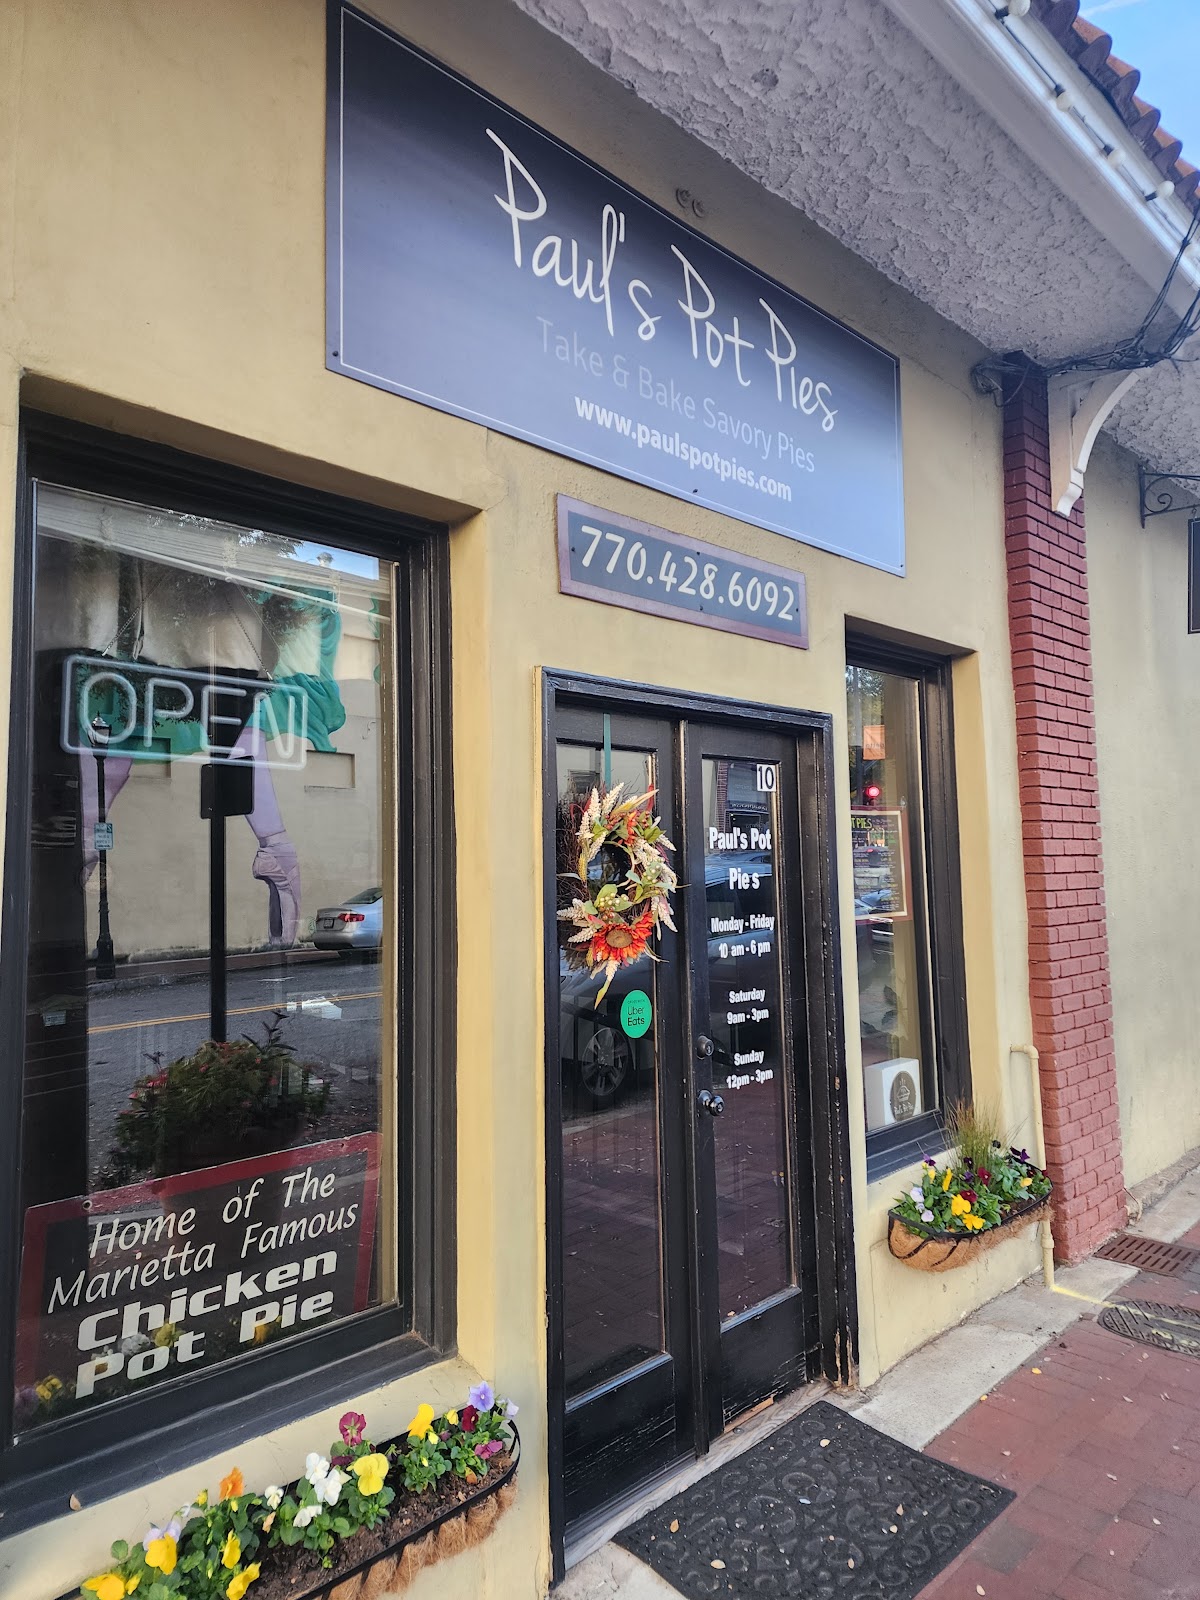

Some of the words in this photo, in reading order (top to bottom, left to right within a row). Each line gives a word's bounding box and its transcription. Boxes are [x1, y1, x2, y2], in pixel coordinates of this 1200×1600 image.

[486, 128, 662, 341] Paul's
[670, 244, 755, 388] Pot
[759, 298, 839, 432] Pies
[536, 316, 603, 377] Take
[613, 354, 631, 391] &
[639, 366, 696, 420] Bake
[704, 397, 773, 461] Savory
[778, 431, 816, 473] Pies
[574, 395, 793, 502] www.paulspotpies.com
[580, 525, 795, 621] 770.428.6092
[80, 671, 296, 761] OPEN
[758, 765, 775, 790] 10
[709, 826, 749, 850] Paul's
[751, 828, 772, 850] Pot
[710, 916, 744, 934] Monday
[749, 913, 775, 930] Friday
[718, 942, 729, 959] 10
[731, 944, 745, 957] am
[750, 939, 757, 954] 6
[757, 940, 771, 957] pm
[729, 987, 766, 1004] Saturday
[627, 1006, 645, 1016] Uber
[627, 1017, 645, 1026] Eats
[726, 1011, 745, 1025] 9am
[751, 1007, 769, 1023] 3pm
[734, 1049, 765, 1067] Sunday
[726, 1074, 750, 1090] 12pm
[755, 1068, 773, 1085] 3pm
[89, 1207, 196, 1259] Home
[222, 1178, 265, 1224] of
[282, 1166, 336, 1207] The
[47, 1241, 217, 1314] Marietta
[241, 1203, 359, 1259] Famous
[77, 1250, 338, 1352] Chicken
[75, 1331, 205, 1400] Pot
[239, 1290, 334, 1343] Pie
